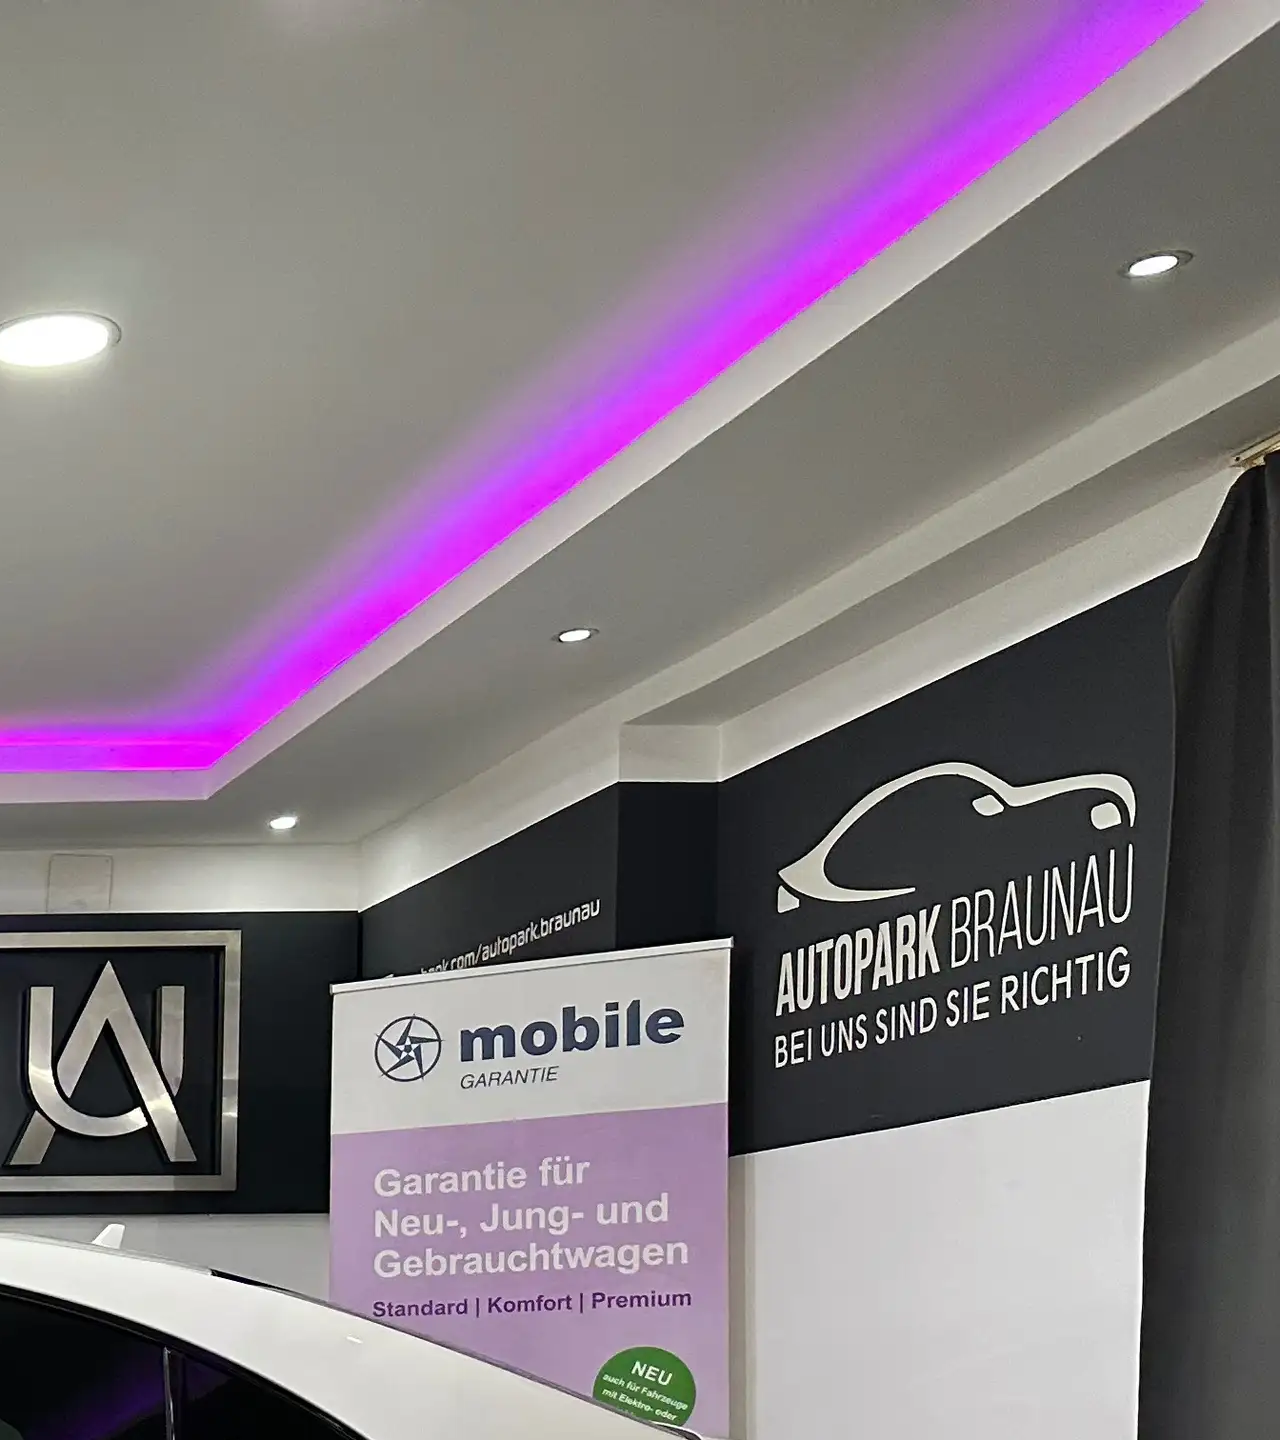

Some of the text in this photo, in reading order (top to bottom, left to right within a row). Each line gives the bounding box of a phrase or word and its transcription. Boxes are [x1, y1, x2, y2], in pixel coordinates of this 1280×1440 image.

[775, 843, 1134, 1017] AUTOPARK BRAUNAU
[775, 946, 1131, 1069] BEI UNS SIND SIE RICHTIG
[460, 999, 685, 1063] mobile
[460, 1065, 560, 1090] GARANTIE
[374, 1155, 591, 1197] Garantie für
[374, 1192, 668, 1239] Neu-, Jung- und
[374, 1241, 688, 1278] Gebrauchtwagen
[372, 1298, 469, 1318] Standard
[487, 1294, 573, 1314] Komfort
[591, 1290, 692, 1310] Premium
[631, 1360, 673, 1386] NEU
[602, 1374, 689, 1410] auch für Fahrzeuge
[602, 1388, 617, 1399] mit
[618, 1393, 654, 1412] Elektro-
[655, 1408, 678, 1421] oder
